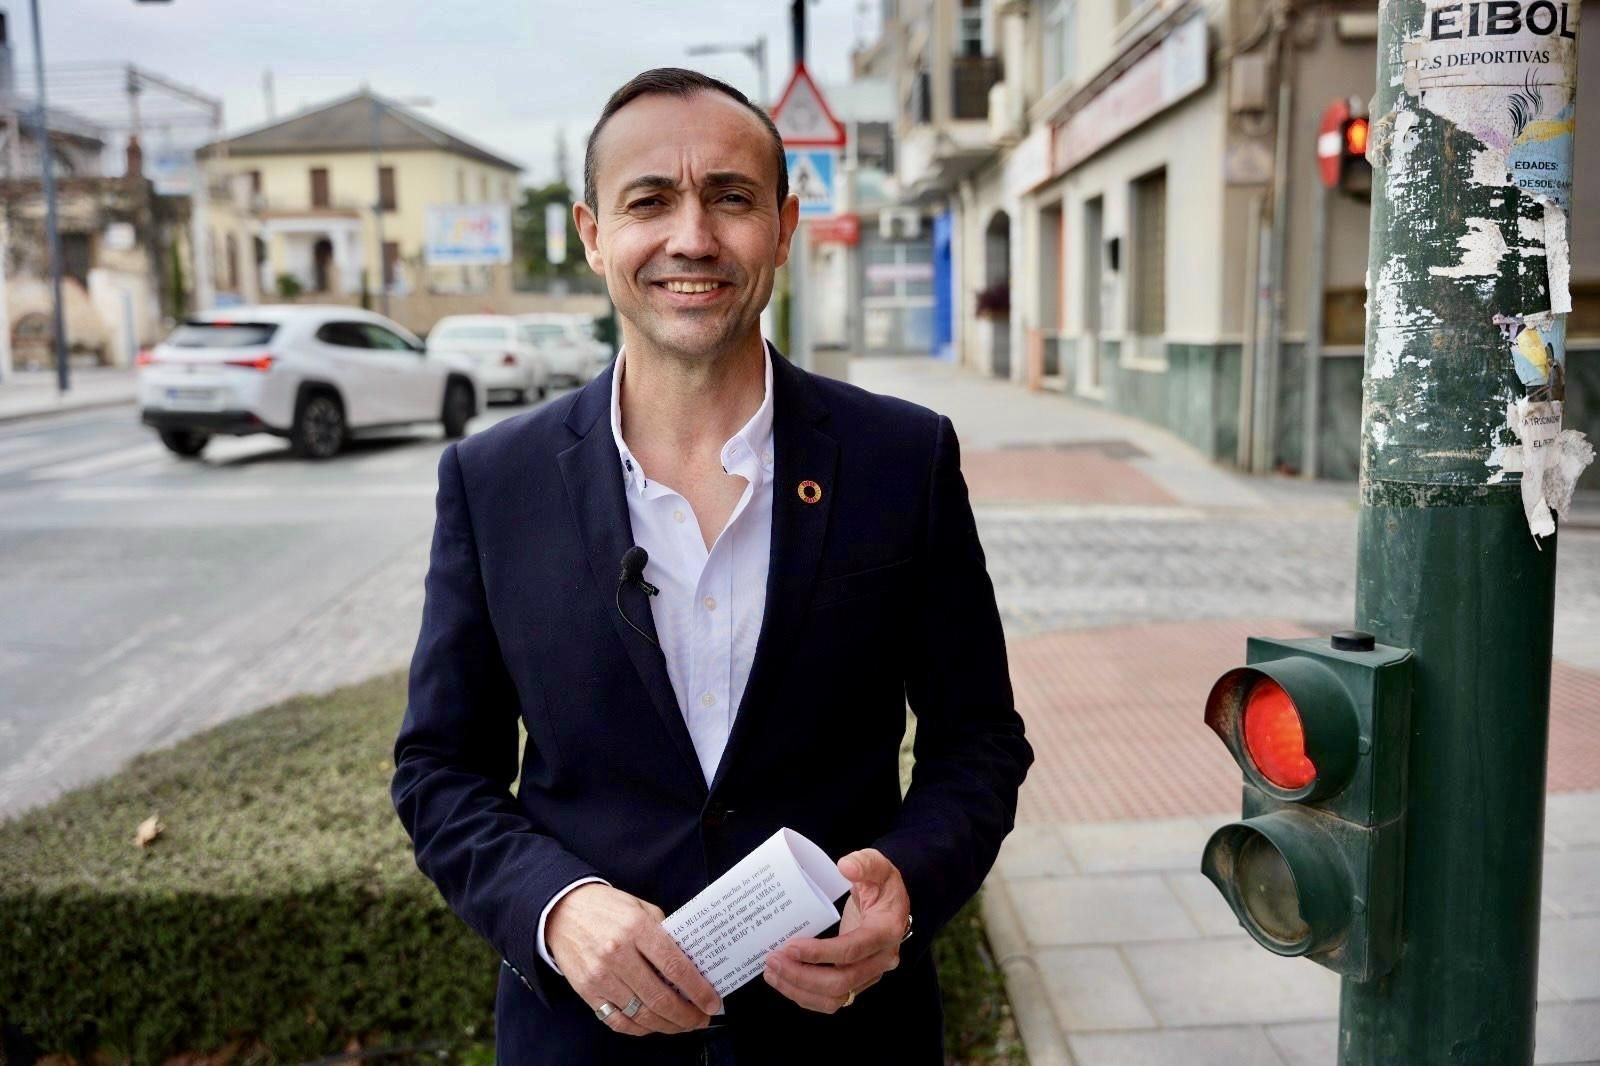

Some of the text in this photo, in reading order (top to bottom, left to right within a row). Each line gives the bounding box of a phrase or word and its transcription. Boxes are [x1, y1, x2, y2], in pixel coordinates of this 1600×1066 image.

[1447, 50, 1550, 67] DEPORTIVAS
[1514, 161, 1559, 170] EDADES:
[734, 905, 747, 915] estar
[754, 884, 775, 901] AMBAS
[683, 907, 709, 927] MULTAS:
[712, 936, 722, 945] por
[726, 926, 736, 934] que
[741, 904, 765, 924] imposible
[680, 935, 689, 943] por
[722, 970, 734, 980] entre
[768, 942, 778, 951] que
[729, 980, 738, 988] por
